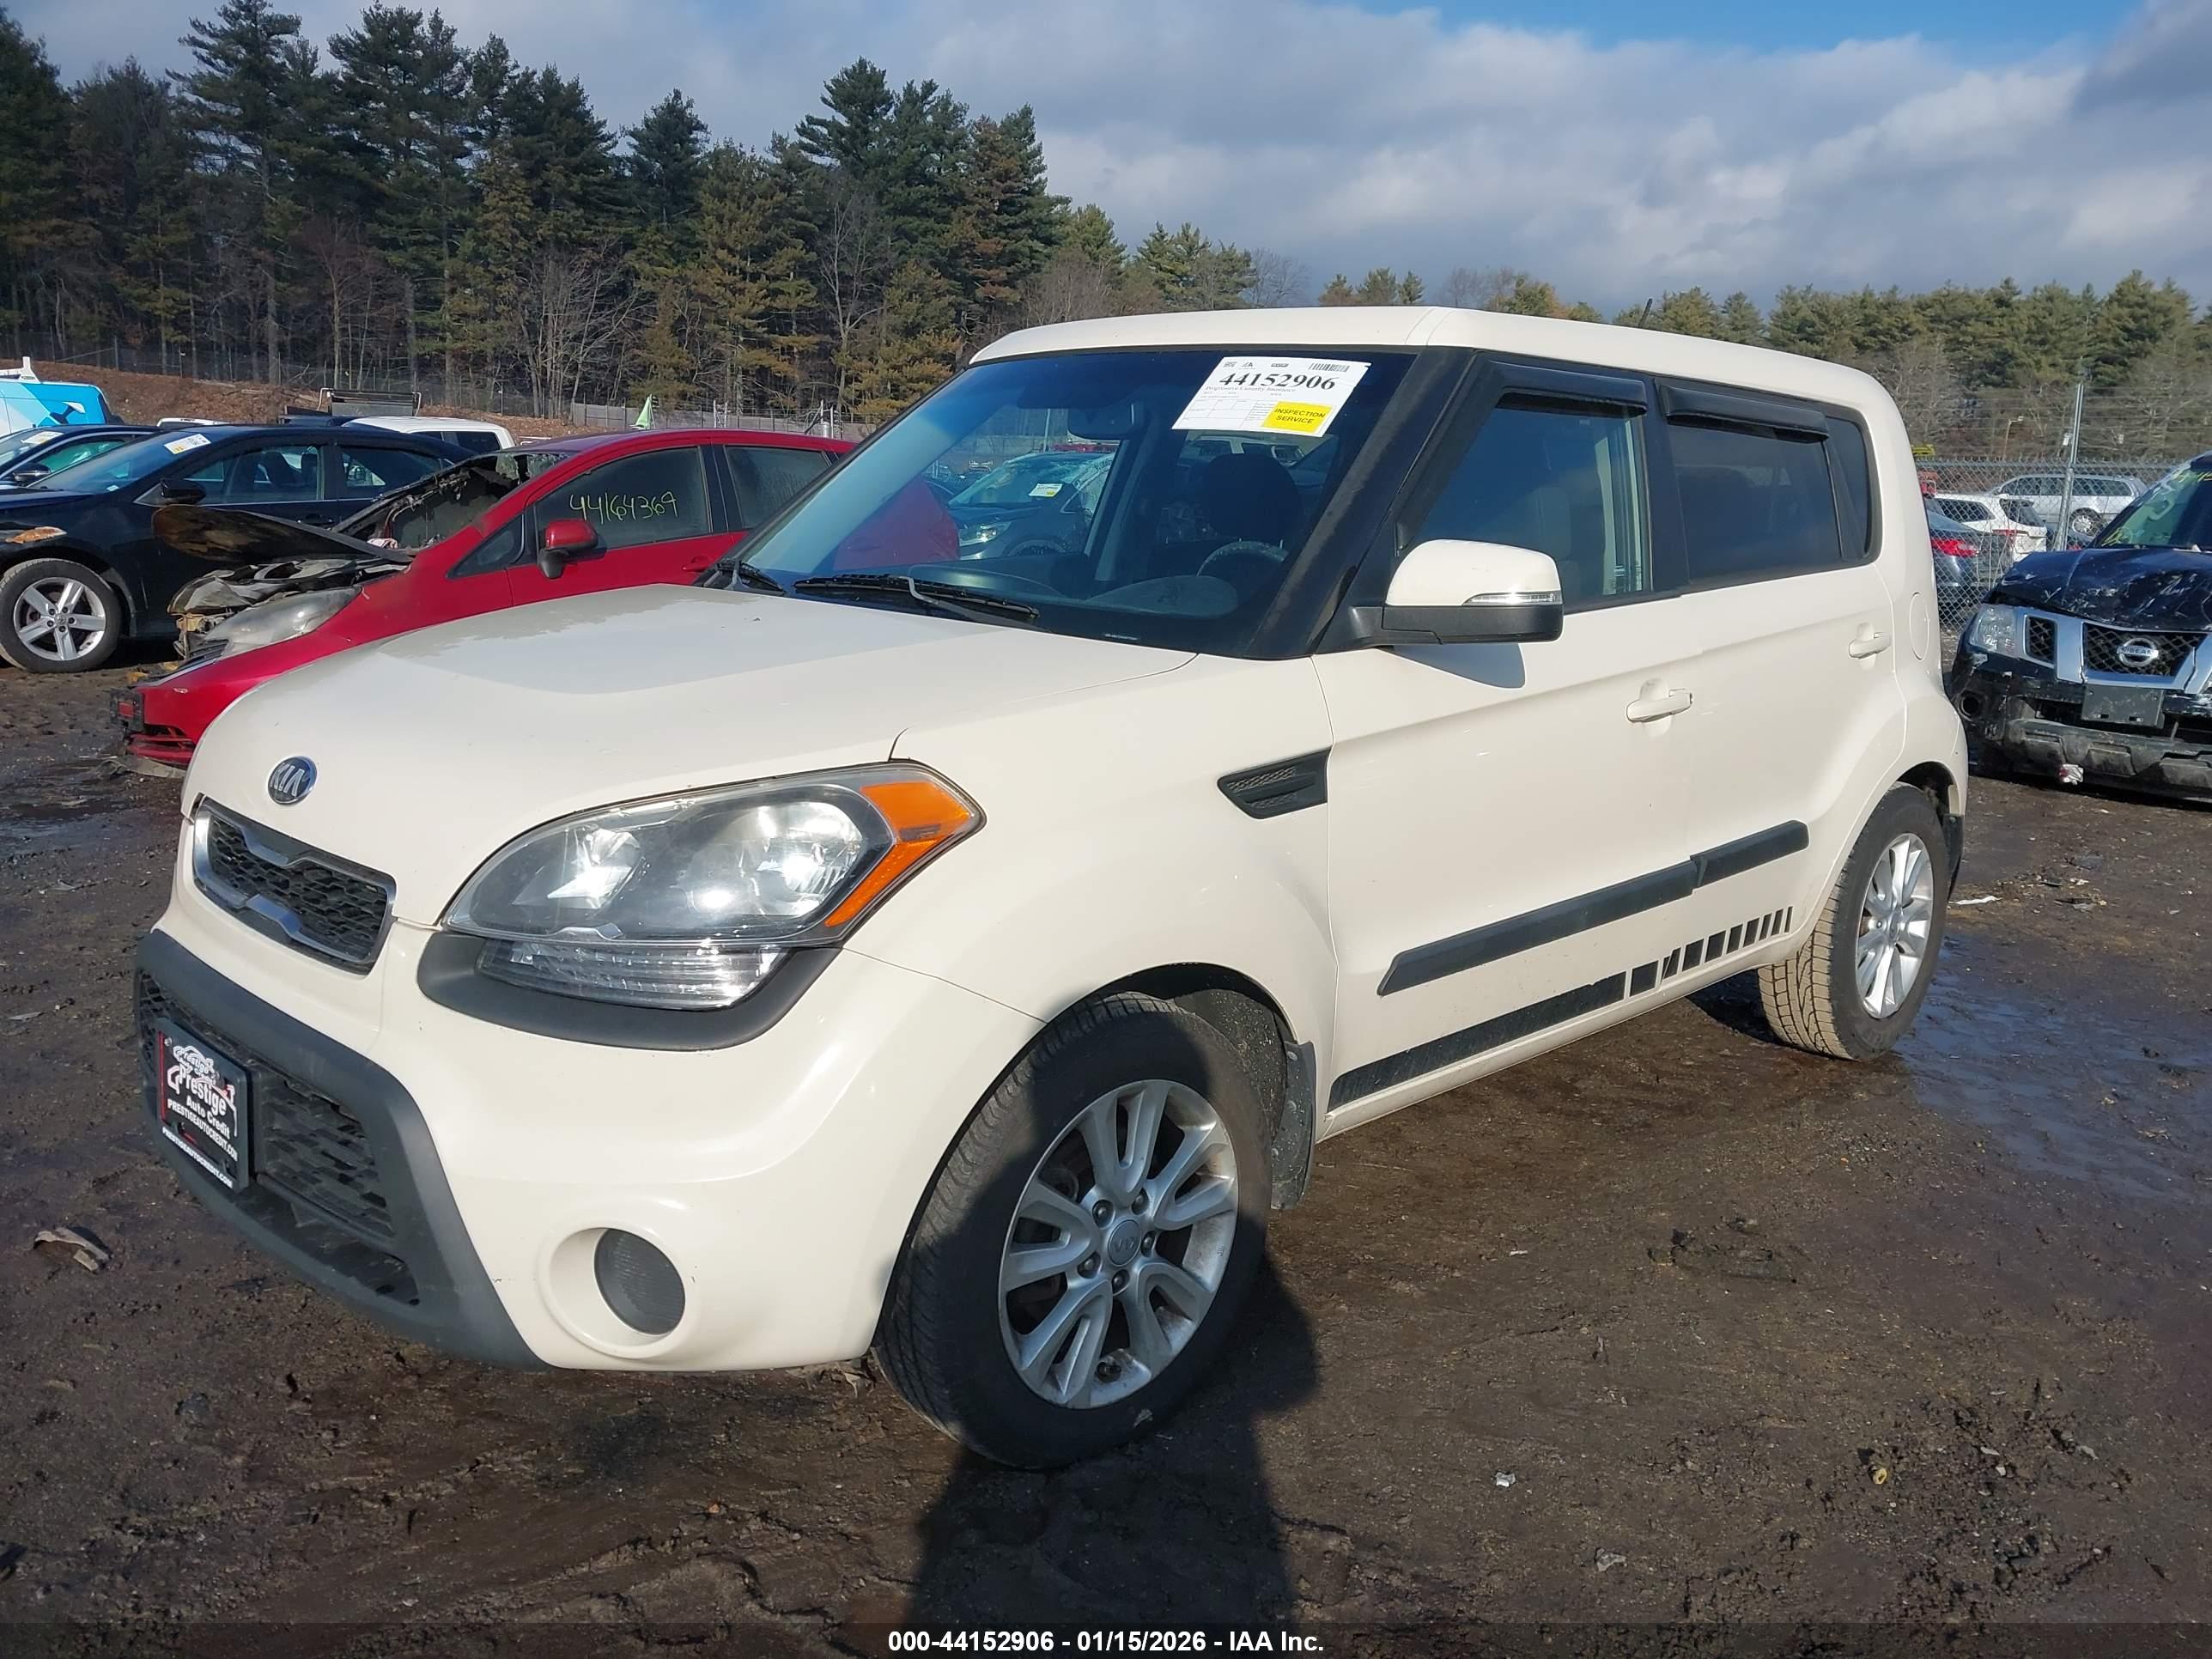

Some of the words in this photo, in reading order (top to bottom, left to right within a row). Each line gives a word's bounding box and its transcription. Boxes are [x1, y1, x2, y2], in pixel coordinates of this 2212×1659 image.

[1219, 373, 1340, 390] 44152906
[1274, 408, 1326, 418] INSPECTION
[1276, 415, 1314, 424] SERVICE
[569, 491, 678, 525] 44164369
[179, 1063, 227, 1116] Prestige
[167, 1098, 238, 1162] PRESTIGEAUTOCREDIT.COM
[186, 1096, 206, 1118] Auto
[207, 1110, 230, 1139] Credit
